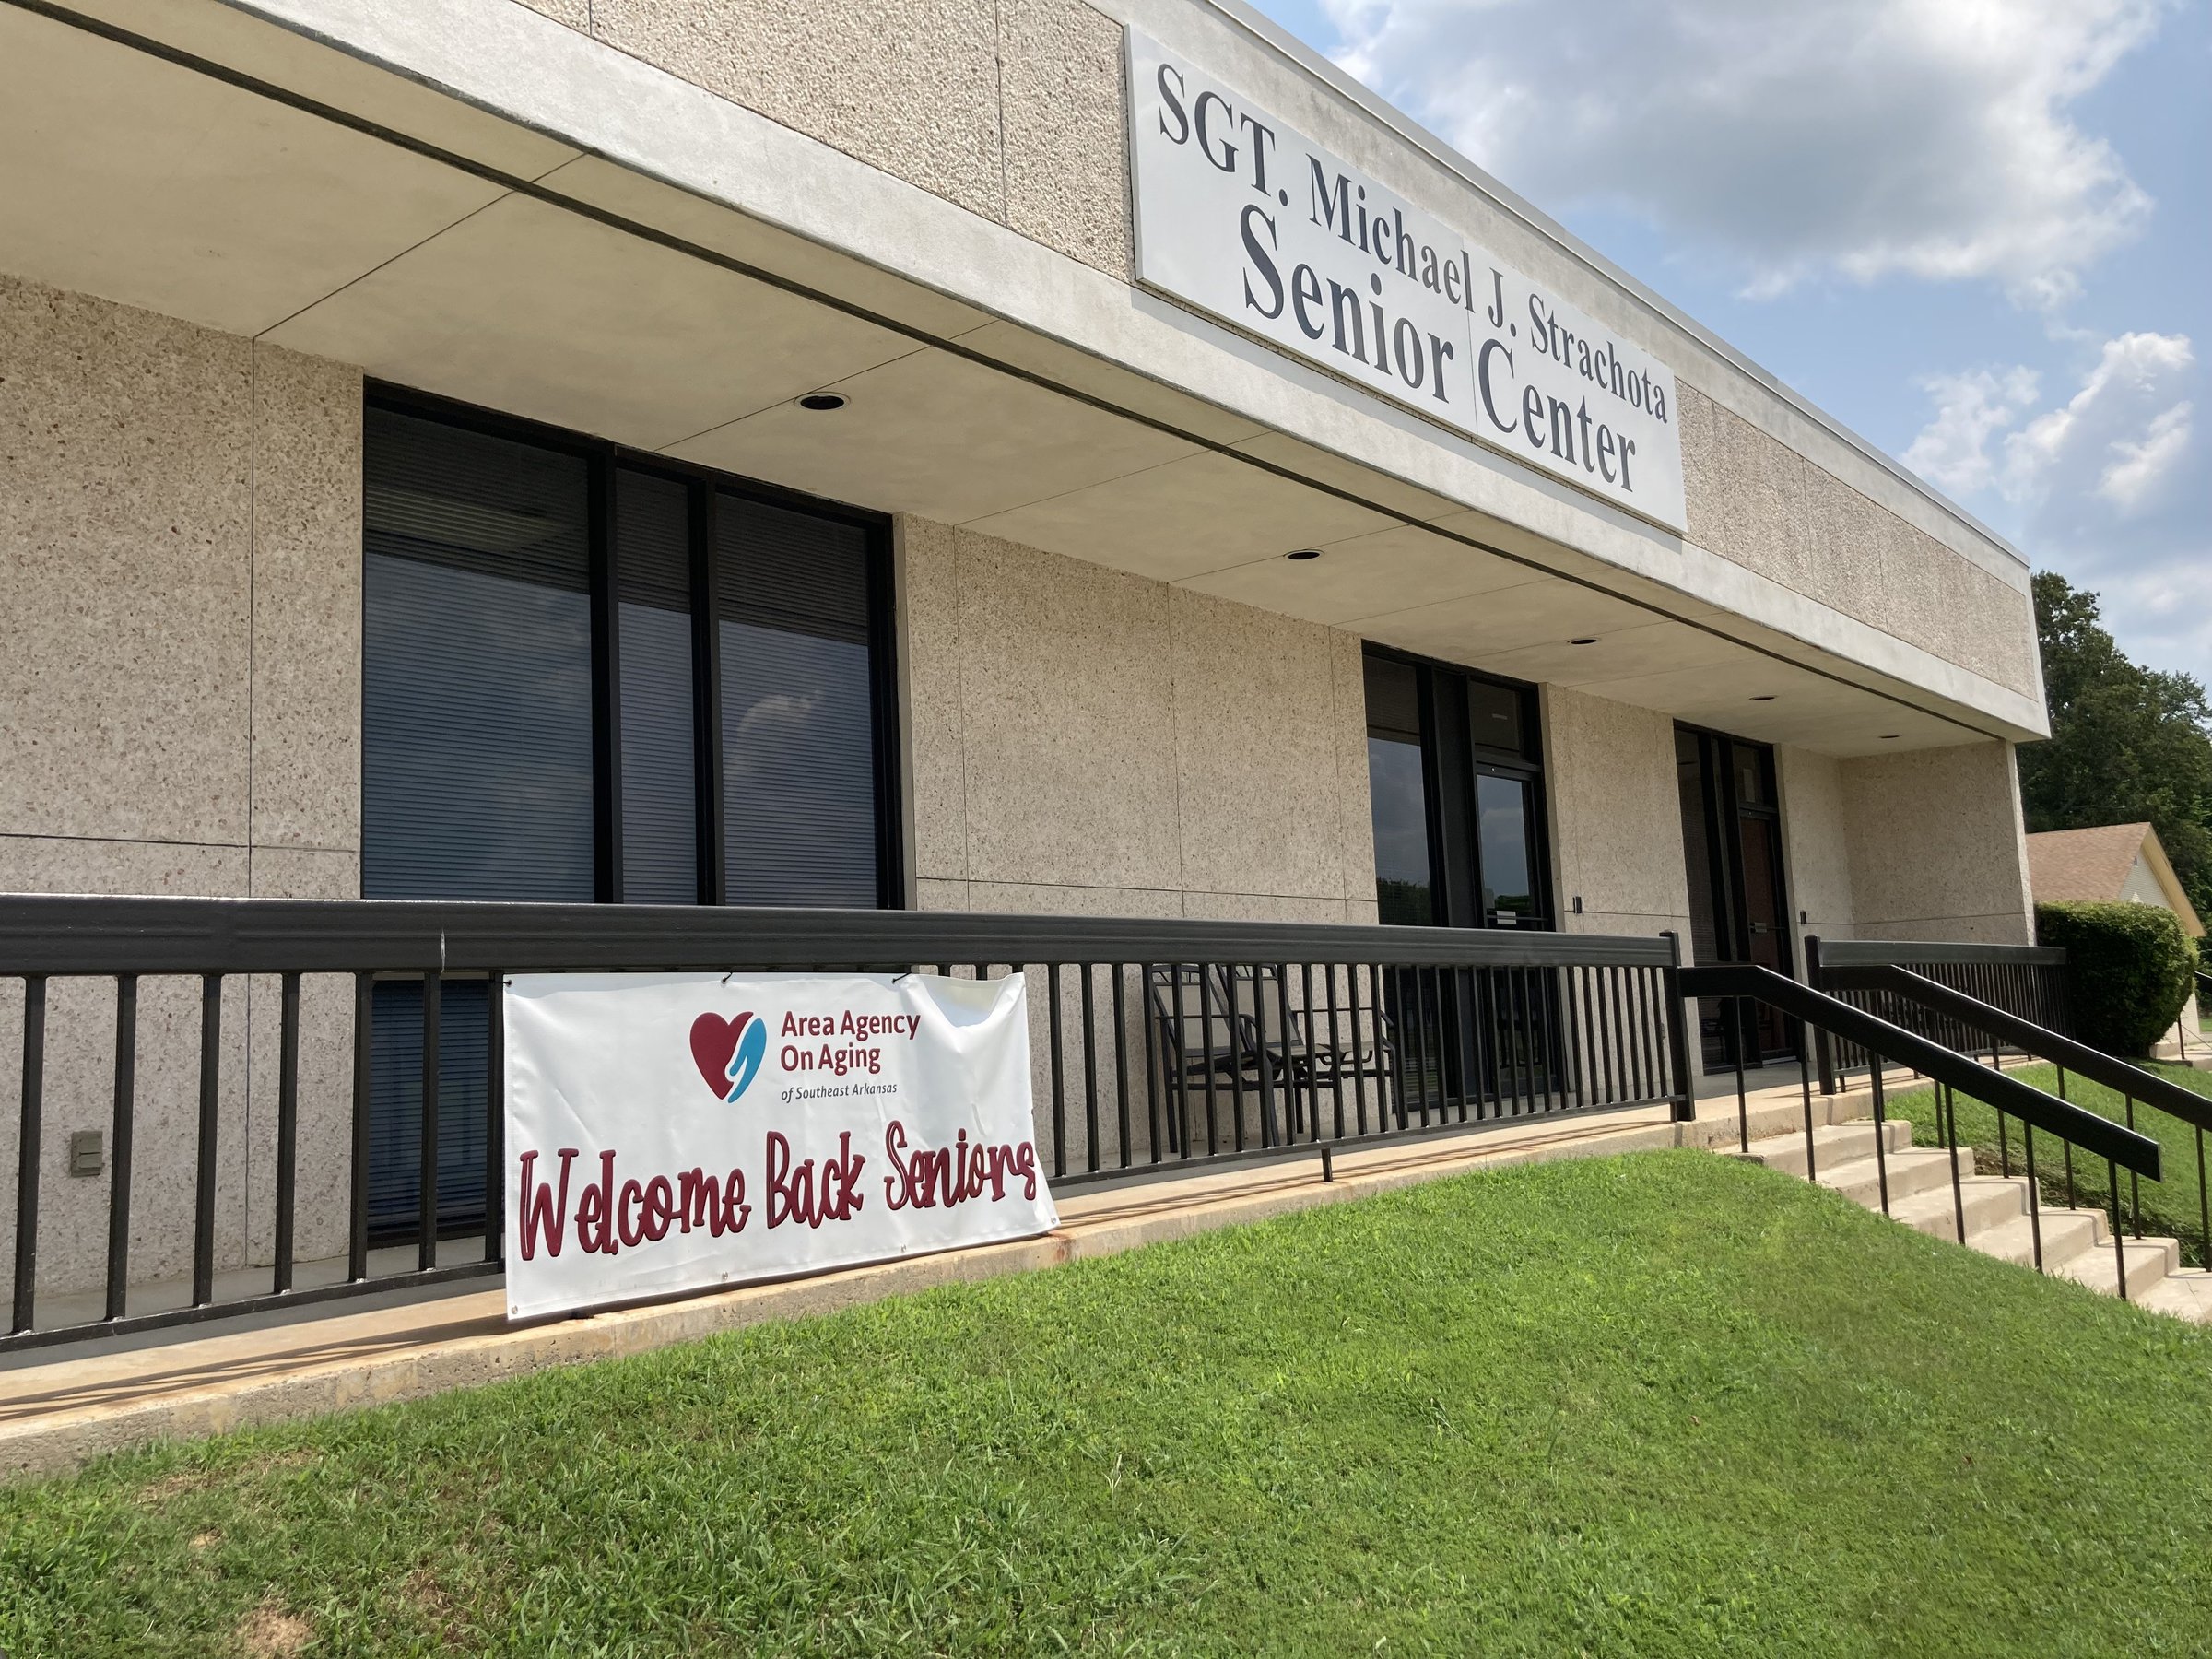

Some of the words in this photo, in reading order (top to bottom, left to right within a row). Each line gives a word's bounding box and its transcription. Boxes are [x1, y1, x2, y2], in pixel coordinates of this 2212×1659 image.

[1157, 64, 1288, 206] SGT.
[1306, 153, 1475, 312] Michael
[1488, 266, 1517, 337] J.
[1528, 293, 1668, 424] Strachota
[1240, 204, 1454, 404] Senior
[1478, 338, 1636, 492] Center
[781, 1010, 835, 1037] Area
[840, 1010, 921, 1041] Agency
[781, 1044, 814, 1071] On
[818, 1042, 881, 1077] Aging
[781, 1086, 794, 1103] of
[795, 1085, 850, 1099] Southeast
[852, 1083, 898, 1097] Arkansas
[520, 1147, 752, 1262] Welcome
[766, 1130, 866, 1229] Back
[884, 1120, 1036, 1212] Seniors
